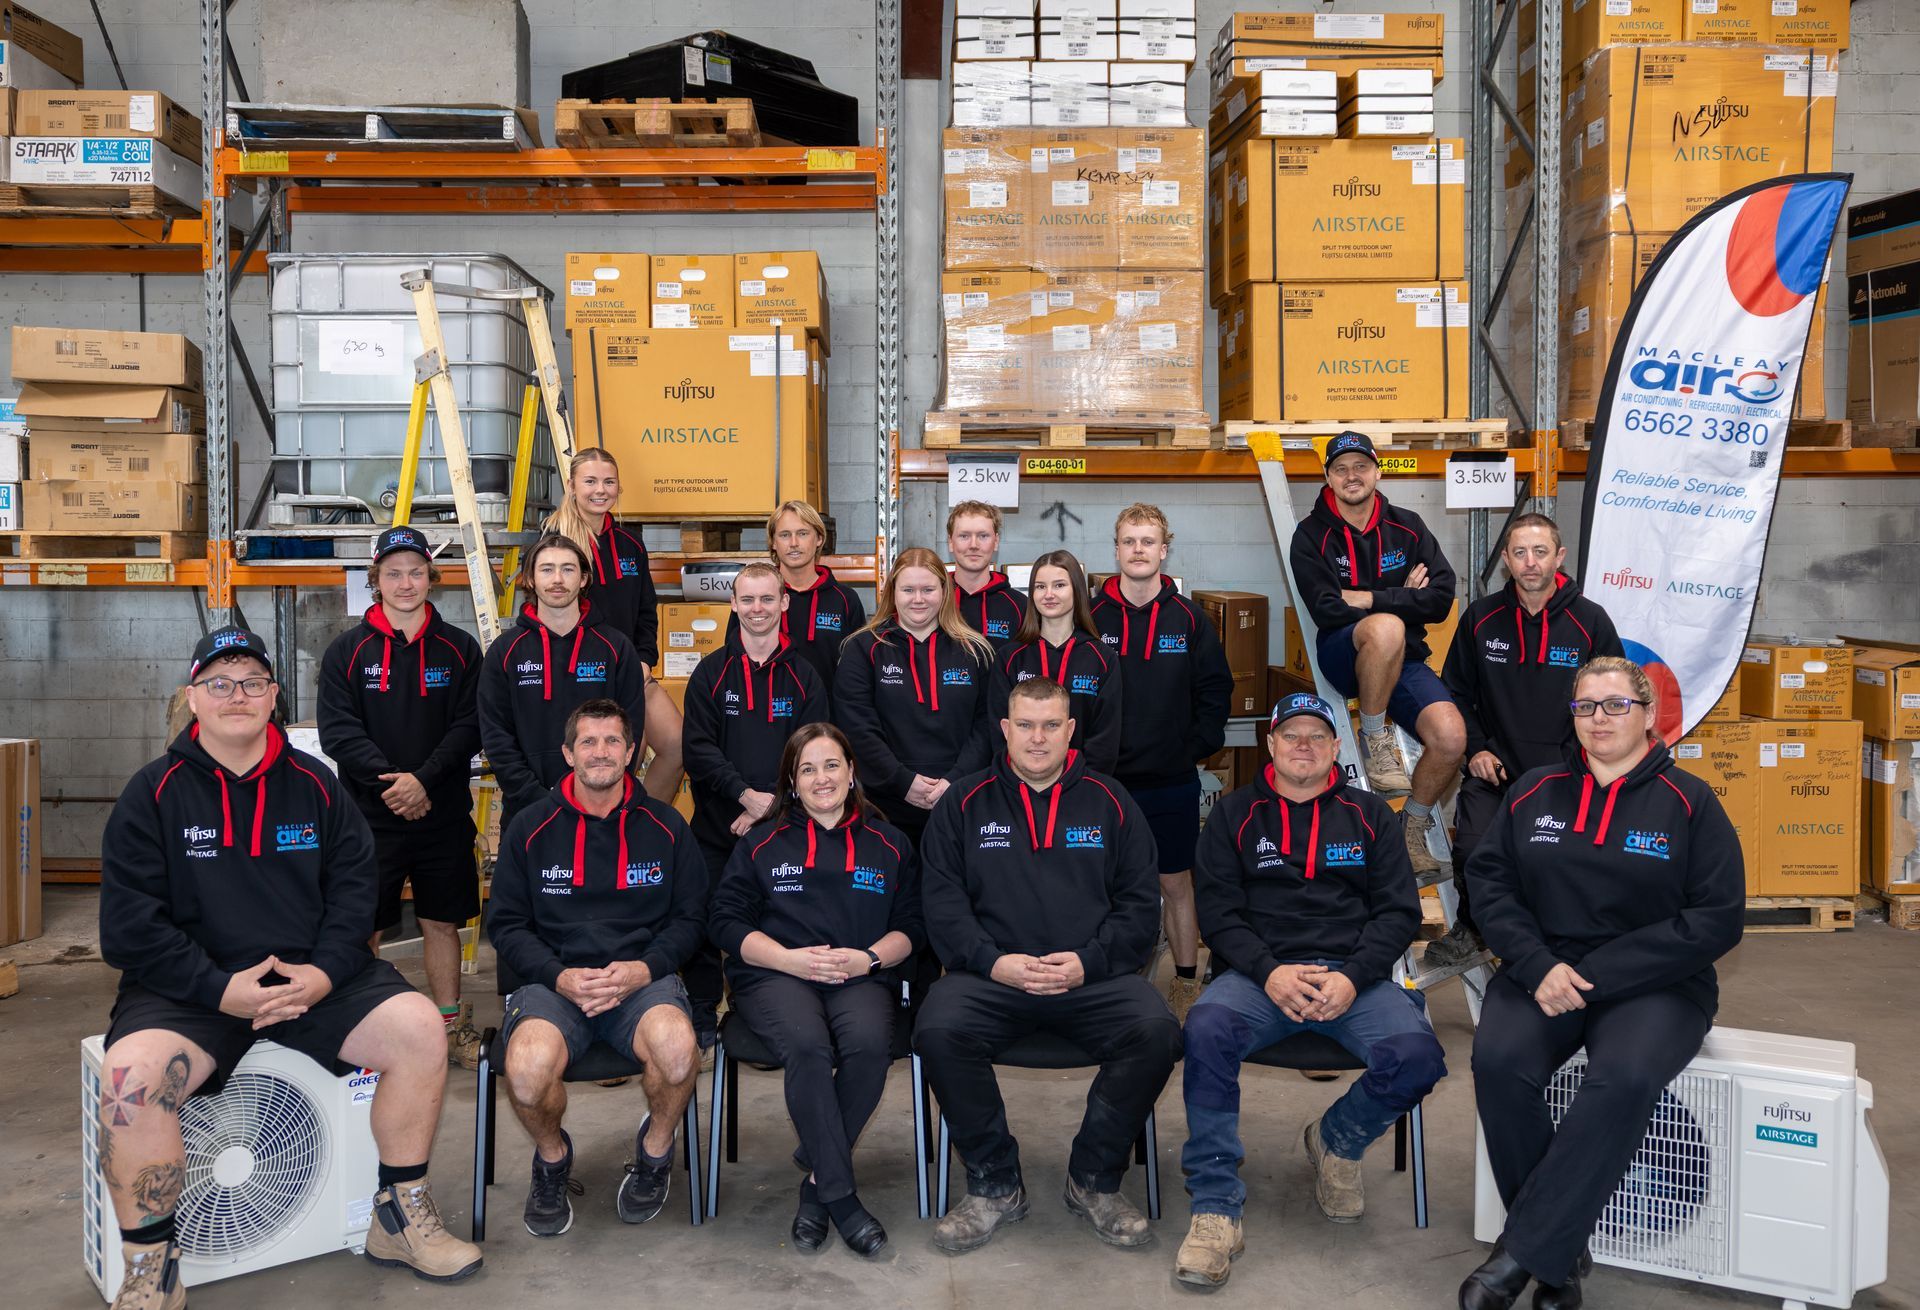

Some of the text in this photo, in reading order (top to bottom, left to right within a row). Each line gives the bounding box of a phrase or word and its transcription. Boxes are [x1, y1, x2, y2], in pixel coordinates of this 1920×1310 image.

[1407, 16, 1435, 30] FUJITSU
[1618, 22, 1665, 30] AIRSTAGE
[1704, 20, 1751, 28] AIRSTAGE
[1783, 21, 1830, 30] AIRSTAGE
[1700, 96, 1749, 119] FUJITSU
[1673, 107, 1731, 142] NSW
[15, 142, 77, 164] STAARK
[124, 142, 149, 151] PAIR
[122, 152, 149, 161] COIL
[1674, 146, 1770, 162] AIRSTAGE
[111, 171, 151, 182] 747112
[1333, 176, 1381, 200] FUJITSU
[955, 214, 1024, 225] AIRSTAGE
[1040, 214, 1108, 225] AIRSTAGE
[1125, 214, 1194, 225] AIRSTAGE
[1312, 217, 1405, 232] AIRSTAGE
[597, 285, 615, 293] FUJITSU
[684, 287, 701, 295] FUJITSU
[767, 285, 785, 293] FUJITSU
[1870, 281, 1907, 300] ActronAir
[755, 299, 796, 307] AIRSTAGE
[1337, 318, 1386, 343] FUJITSU
[343, 339, 385, 357] 630 kg
[1638, 347, 1789, 371] MACLEAY
[1317, 359, 1410, 374] AIRSTAGE
[664, 378, 715, 403] FUJITSU
[1621, 393, 1782, 419] AIR CONDITIONING REFRIGERATION ELECTRICAL
[1625, 409, 1769, 445] 6562 3380
[641, 428, 738, 443] AIRSTAGE
[1028, 459, 1084, 470] G-04-60-01
[957, 468, 1010, 483] 2.5kw
[1455, 469, 1507, 484] 3.5kw
[1612, 469, 1748, 499] Reliable Service,
[1602, 491, 1757, 523] Comfortable Living
[1602, 567, 1744, 600] FUJITSU AIRSTAGE
[1486, 638, 1509, 651] FUJITSU
[1486, 654, 1507, 663] AIRSTAGE
[517, 660, 543, 673] FUJITSU
[882, 663, 903, 675] FUJITSU
[1348, 765, 1356, 778] 4
[1791, 780, 1829, 798] FUJITSU
[980, 822, 1010, 836] FUJITSU
[1535, 815, 1566, 829] FUJITSU
[1776, 823, 1845, 835] AIRSTAGE
[1530, 835, 1560, 843] AIRSTAGE
[542, 865, 572, 880] FUJITSU
[772, 863, 802, 878] FUJITSU
[542, 887, 571, 895] AIRSTAGE
[349, 1074, 381, 1088] GREE
[1764, 1102, 1811, 1123] FUJITSU
[1759, 1128, 1815, 1145] AIRSTAGE
